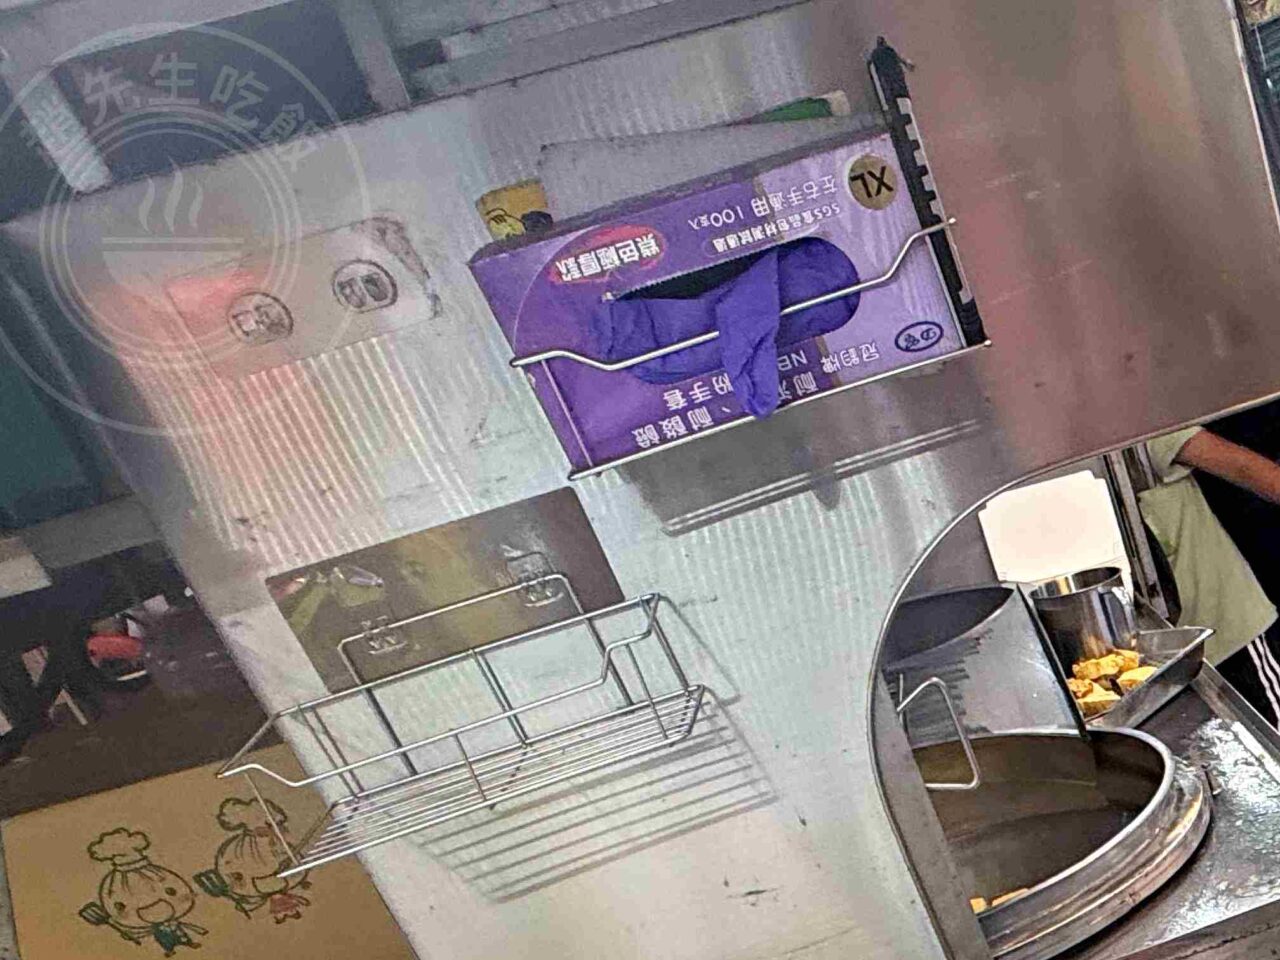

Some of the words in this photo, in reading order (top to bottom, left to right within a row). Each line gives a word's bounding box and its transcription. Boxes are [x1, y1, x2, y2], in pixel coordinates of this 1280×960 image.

[750, 174, 838, 217] 左右手通用
[850, 166, 894, 198] XL
[687, 205, 745, 231] 100支入
[555, 233, 661, 281] 紫色極厚款
